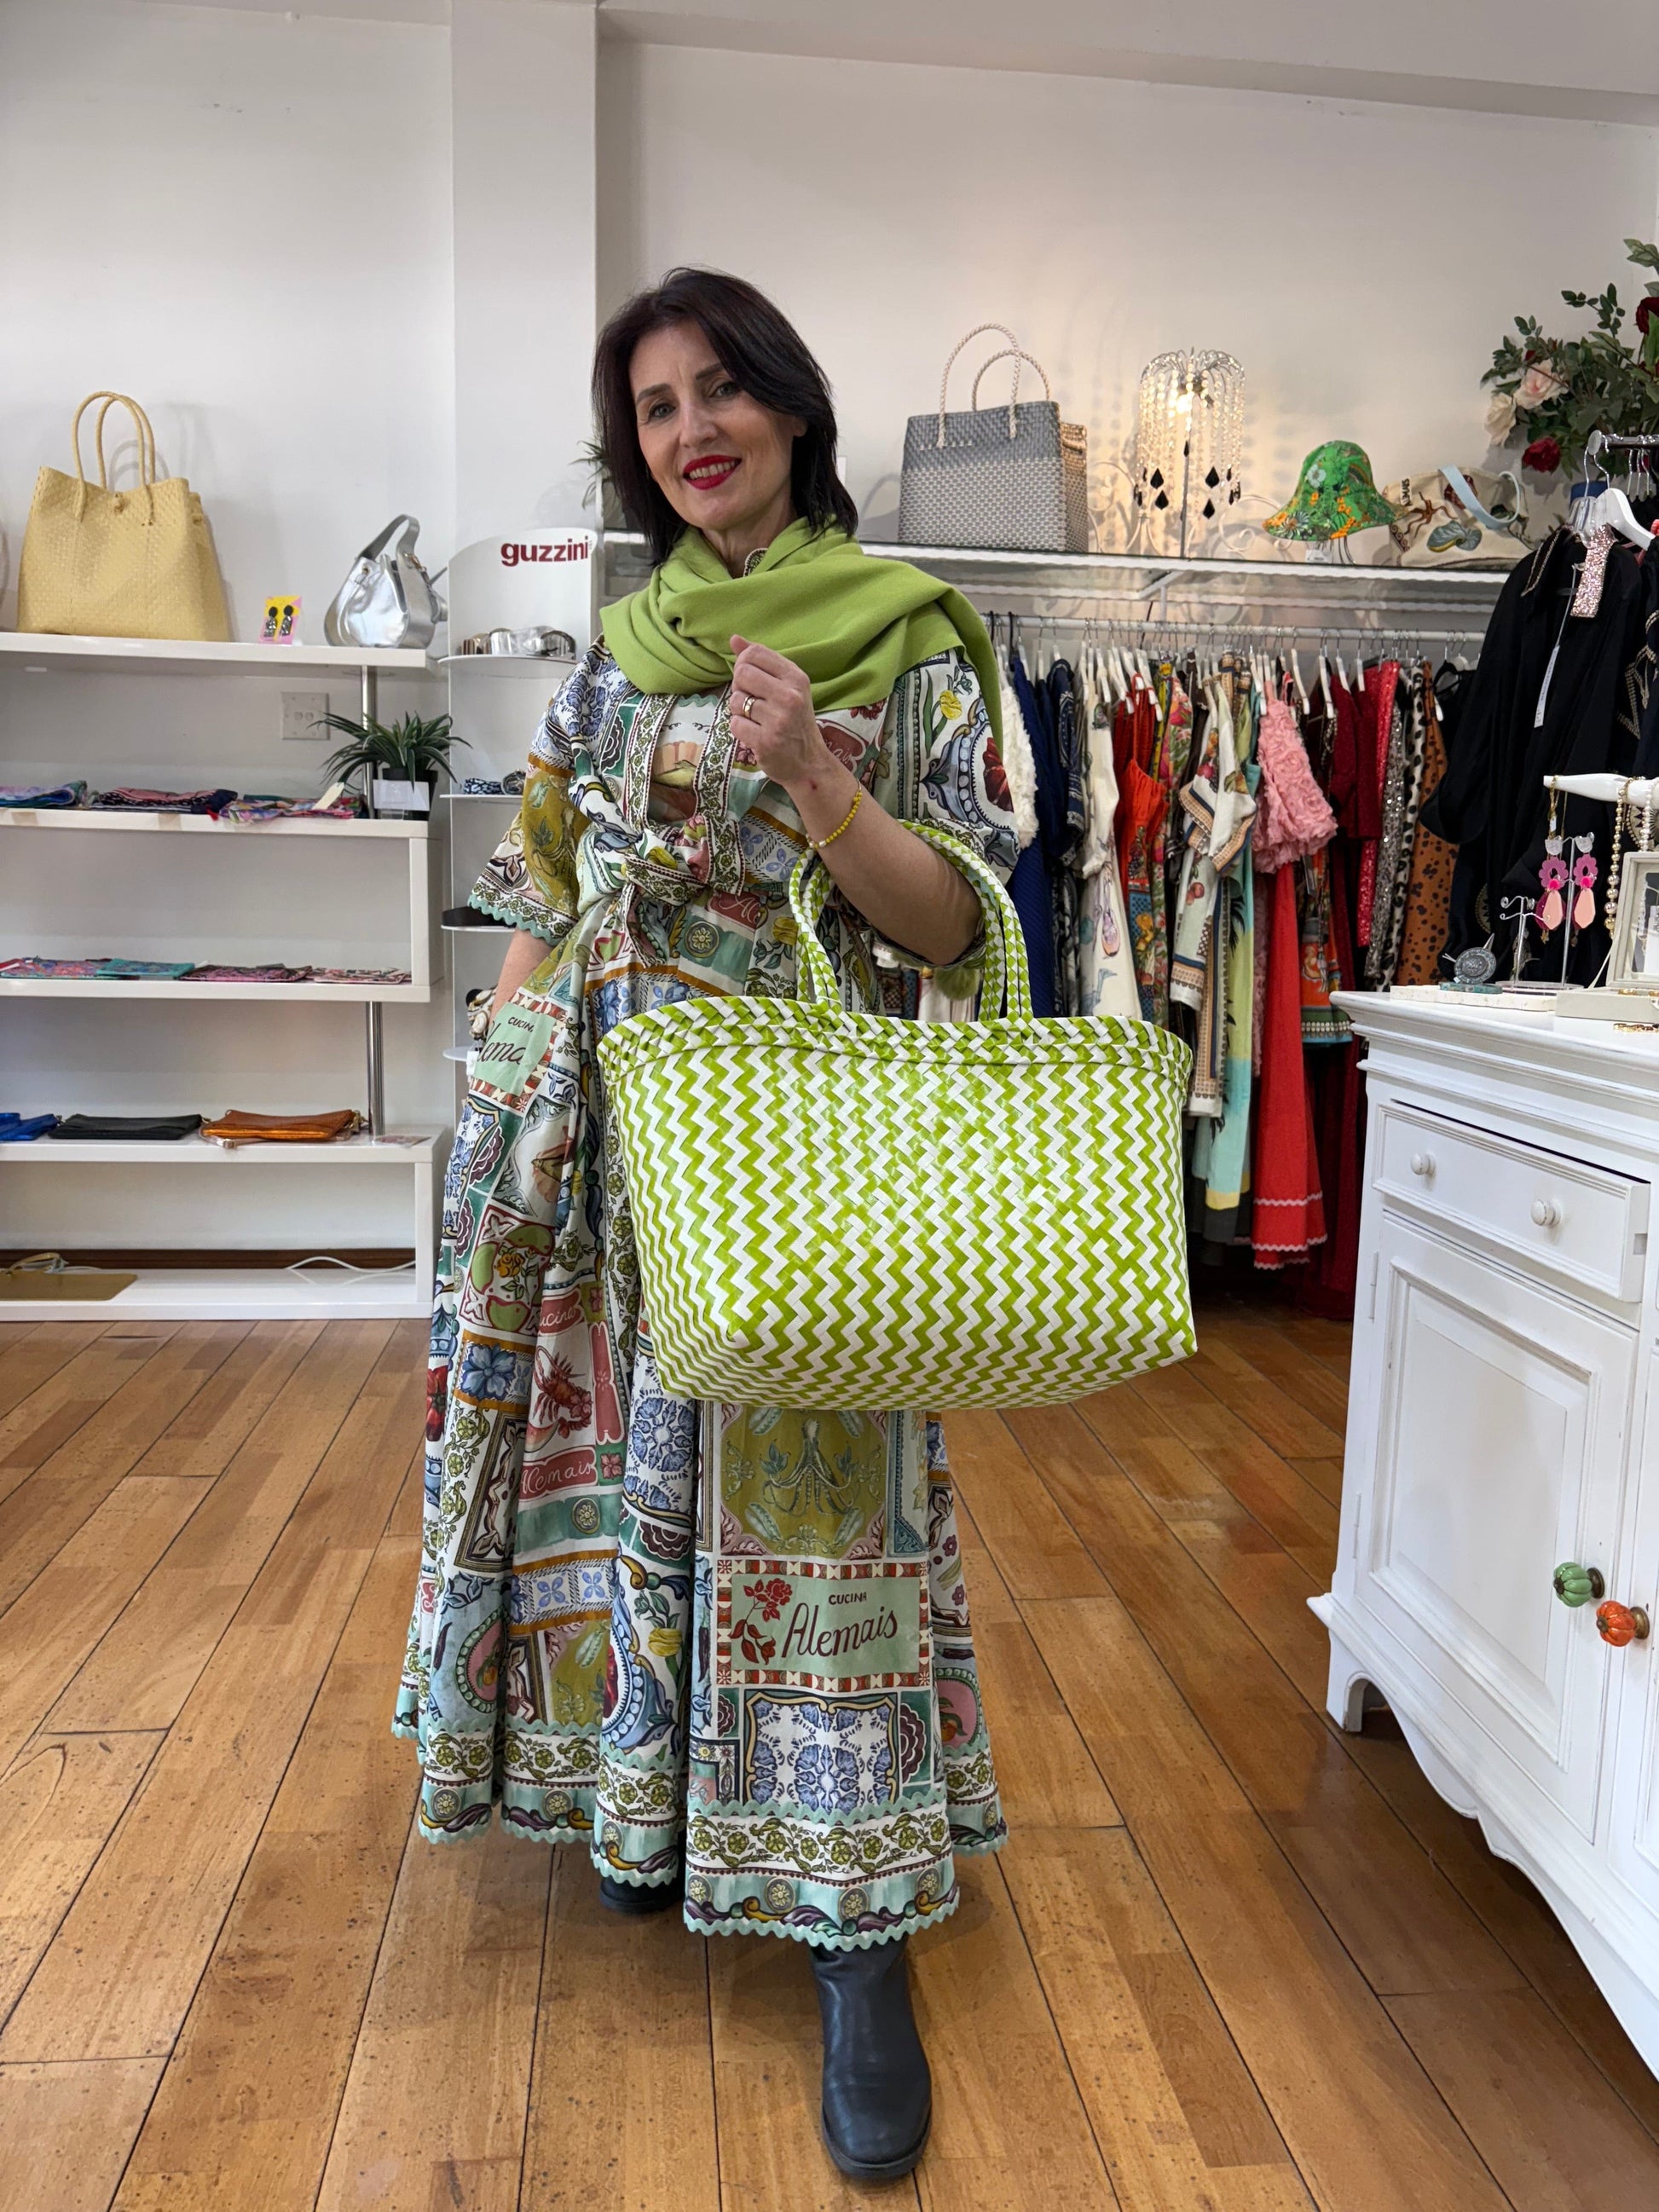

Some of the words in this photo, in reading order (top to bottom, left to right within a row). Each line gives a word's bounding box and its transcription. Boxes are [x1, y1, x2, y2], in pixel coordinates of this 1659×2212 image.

[500, 535, 588, 567] guzzini
[507, 1017, 535, 1033] CUCIN
[828, 1591, 867, 1605] CUCINA
[781, 1603, 898, 1658] Alemais
